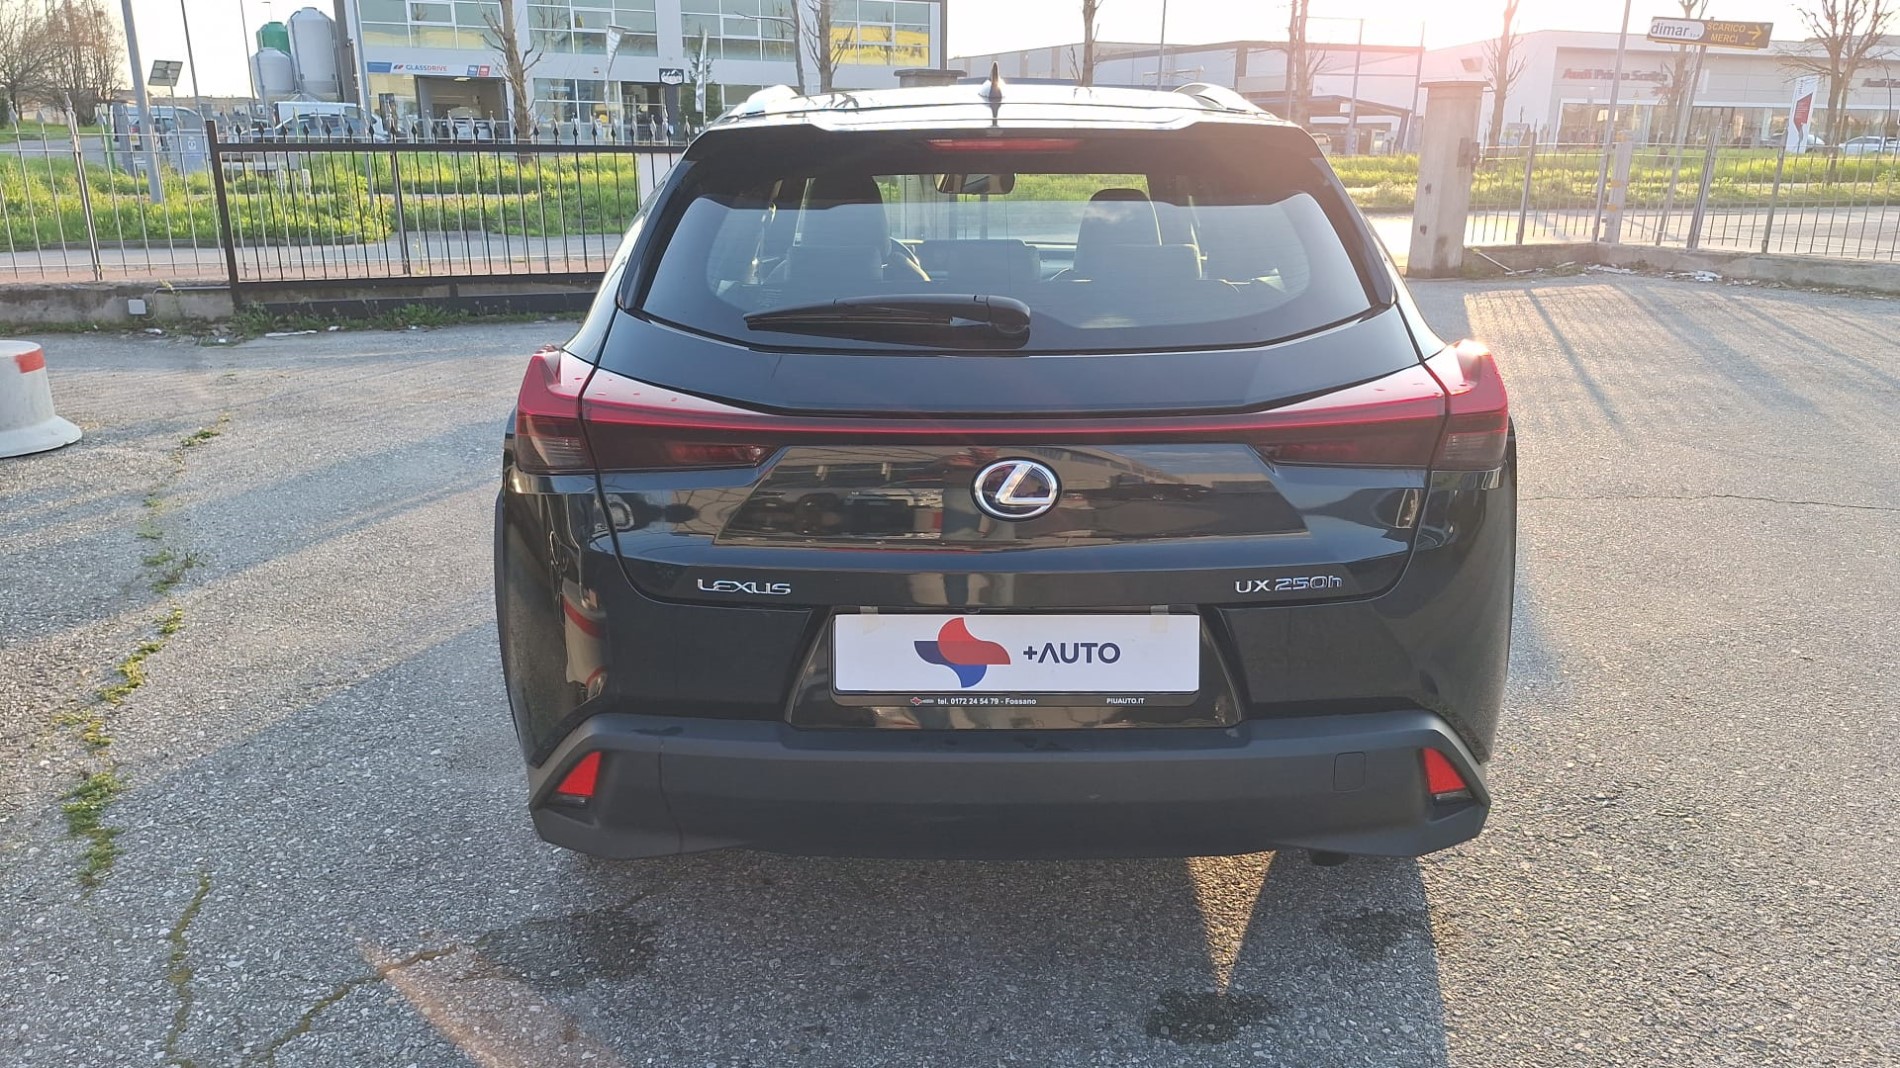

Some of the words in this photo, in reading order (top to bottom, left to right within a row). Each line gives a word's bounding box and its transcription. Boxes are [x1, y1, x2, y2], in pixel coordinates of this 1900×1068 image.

[1650, 22, 1690, 37] dimar
[1706, 21, 1746, 33] SCARICO
[1710, 33, 1739, 44] MERCI
[405, 64, 448, 72] GLASSDRIVE
[697, 578, 791, 595] LEXUS
[1234, 579, 1271, 593] UX
[1274, 575, 1343, 591] 250h
[1005, 697, 1037, 705] Fossano
